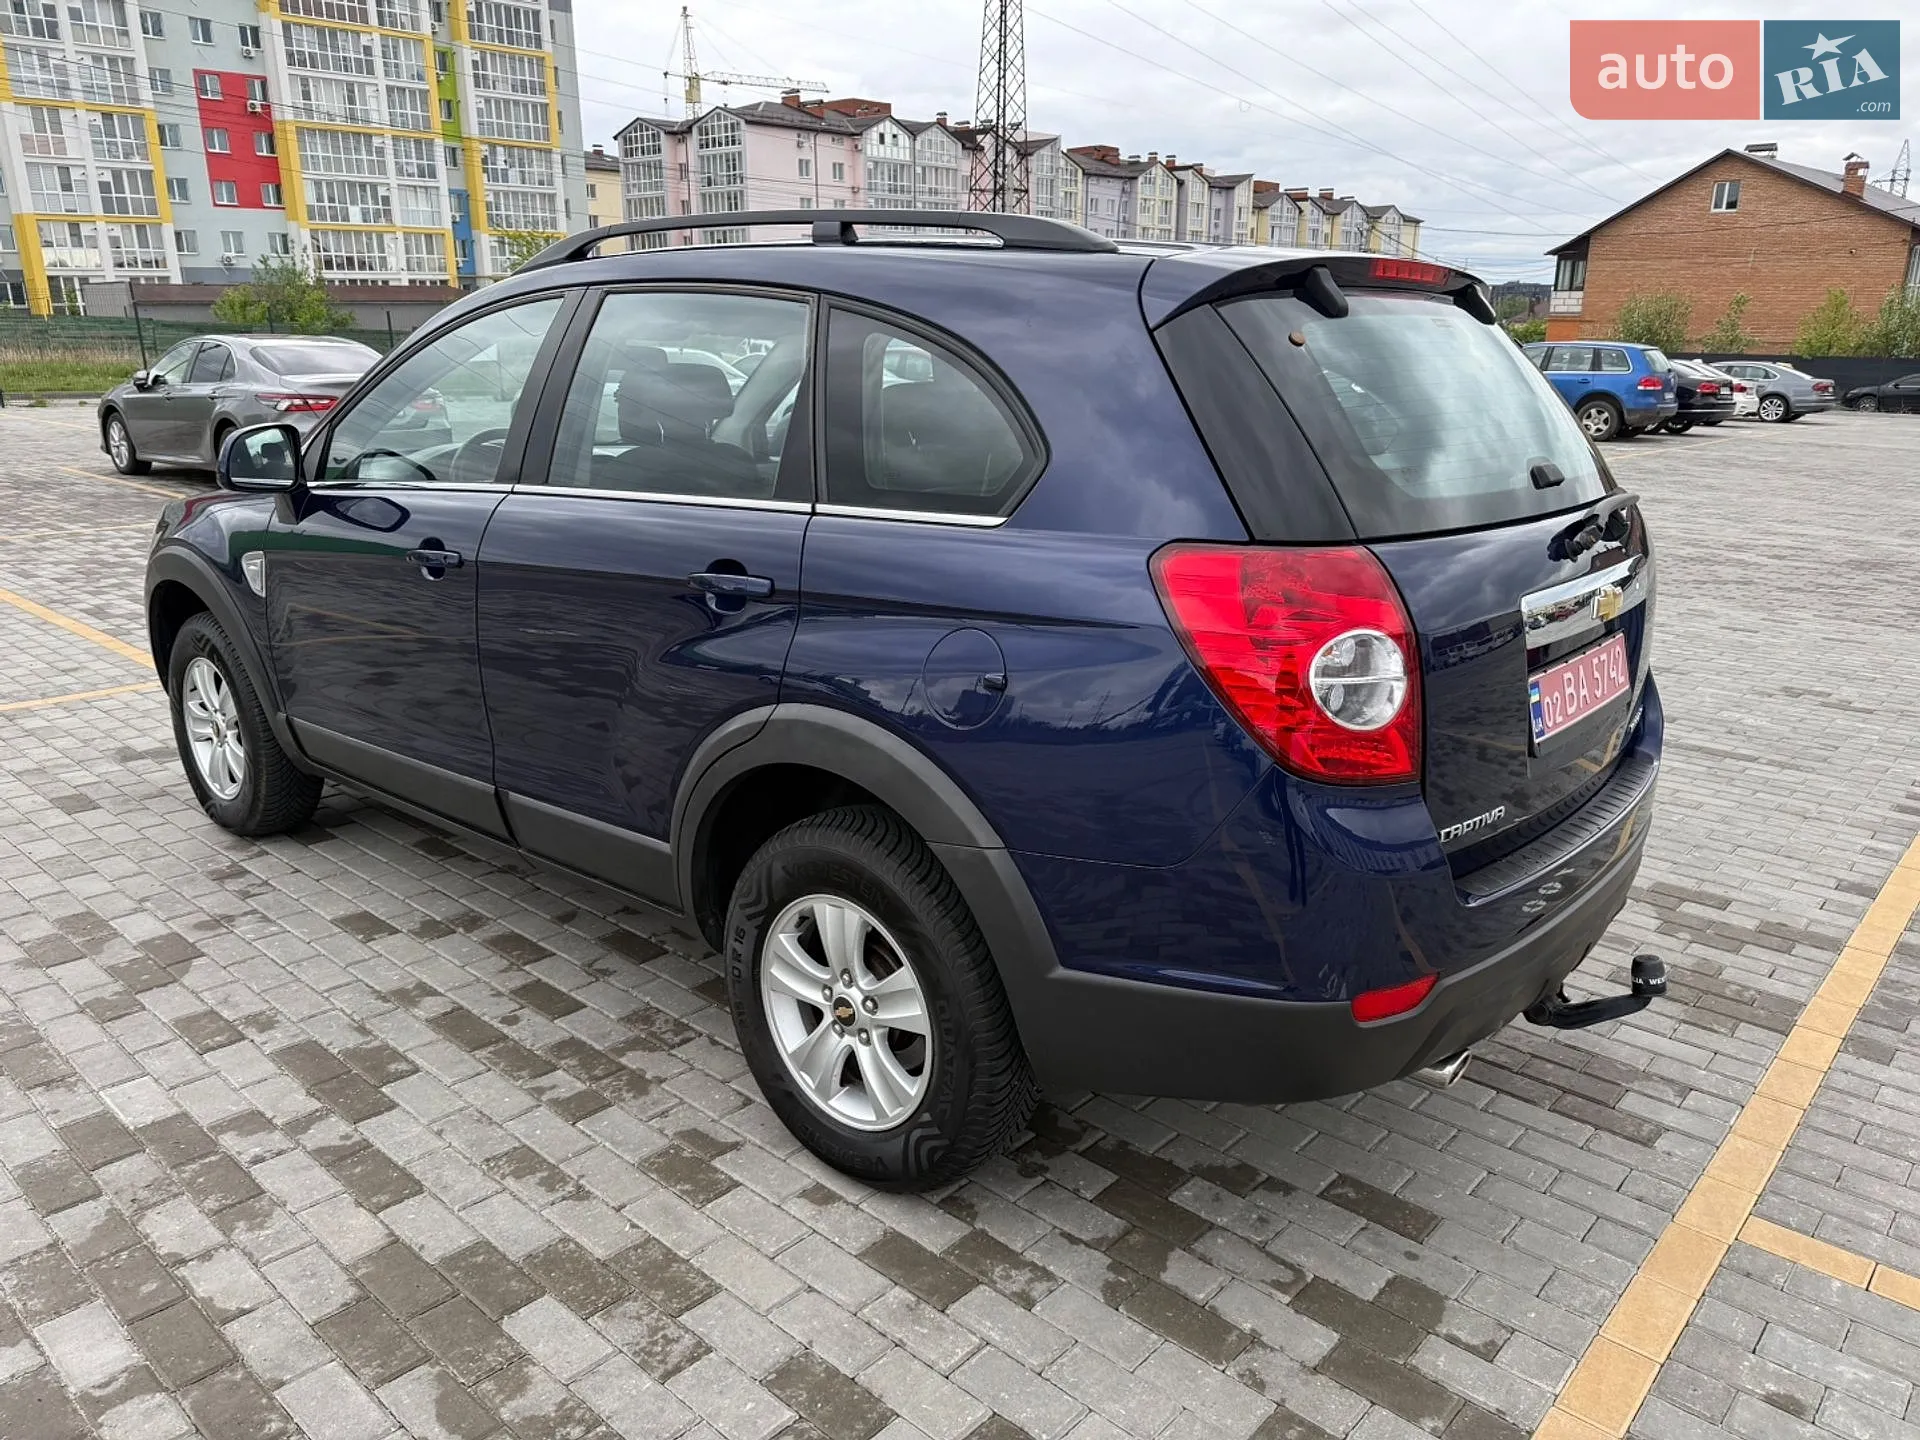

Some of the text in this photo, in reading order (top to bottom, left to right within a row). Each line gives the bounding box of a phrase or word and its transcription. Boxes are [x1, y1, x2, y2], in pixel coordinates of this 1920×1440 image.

[1543, 645, 1625, 729] 02 BA 5742
[1440, 805, 1506, 843] CAPTIVA
